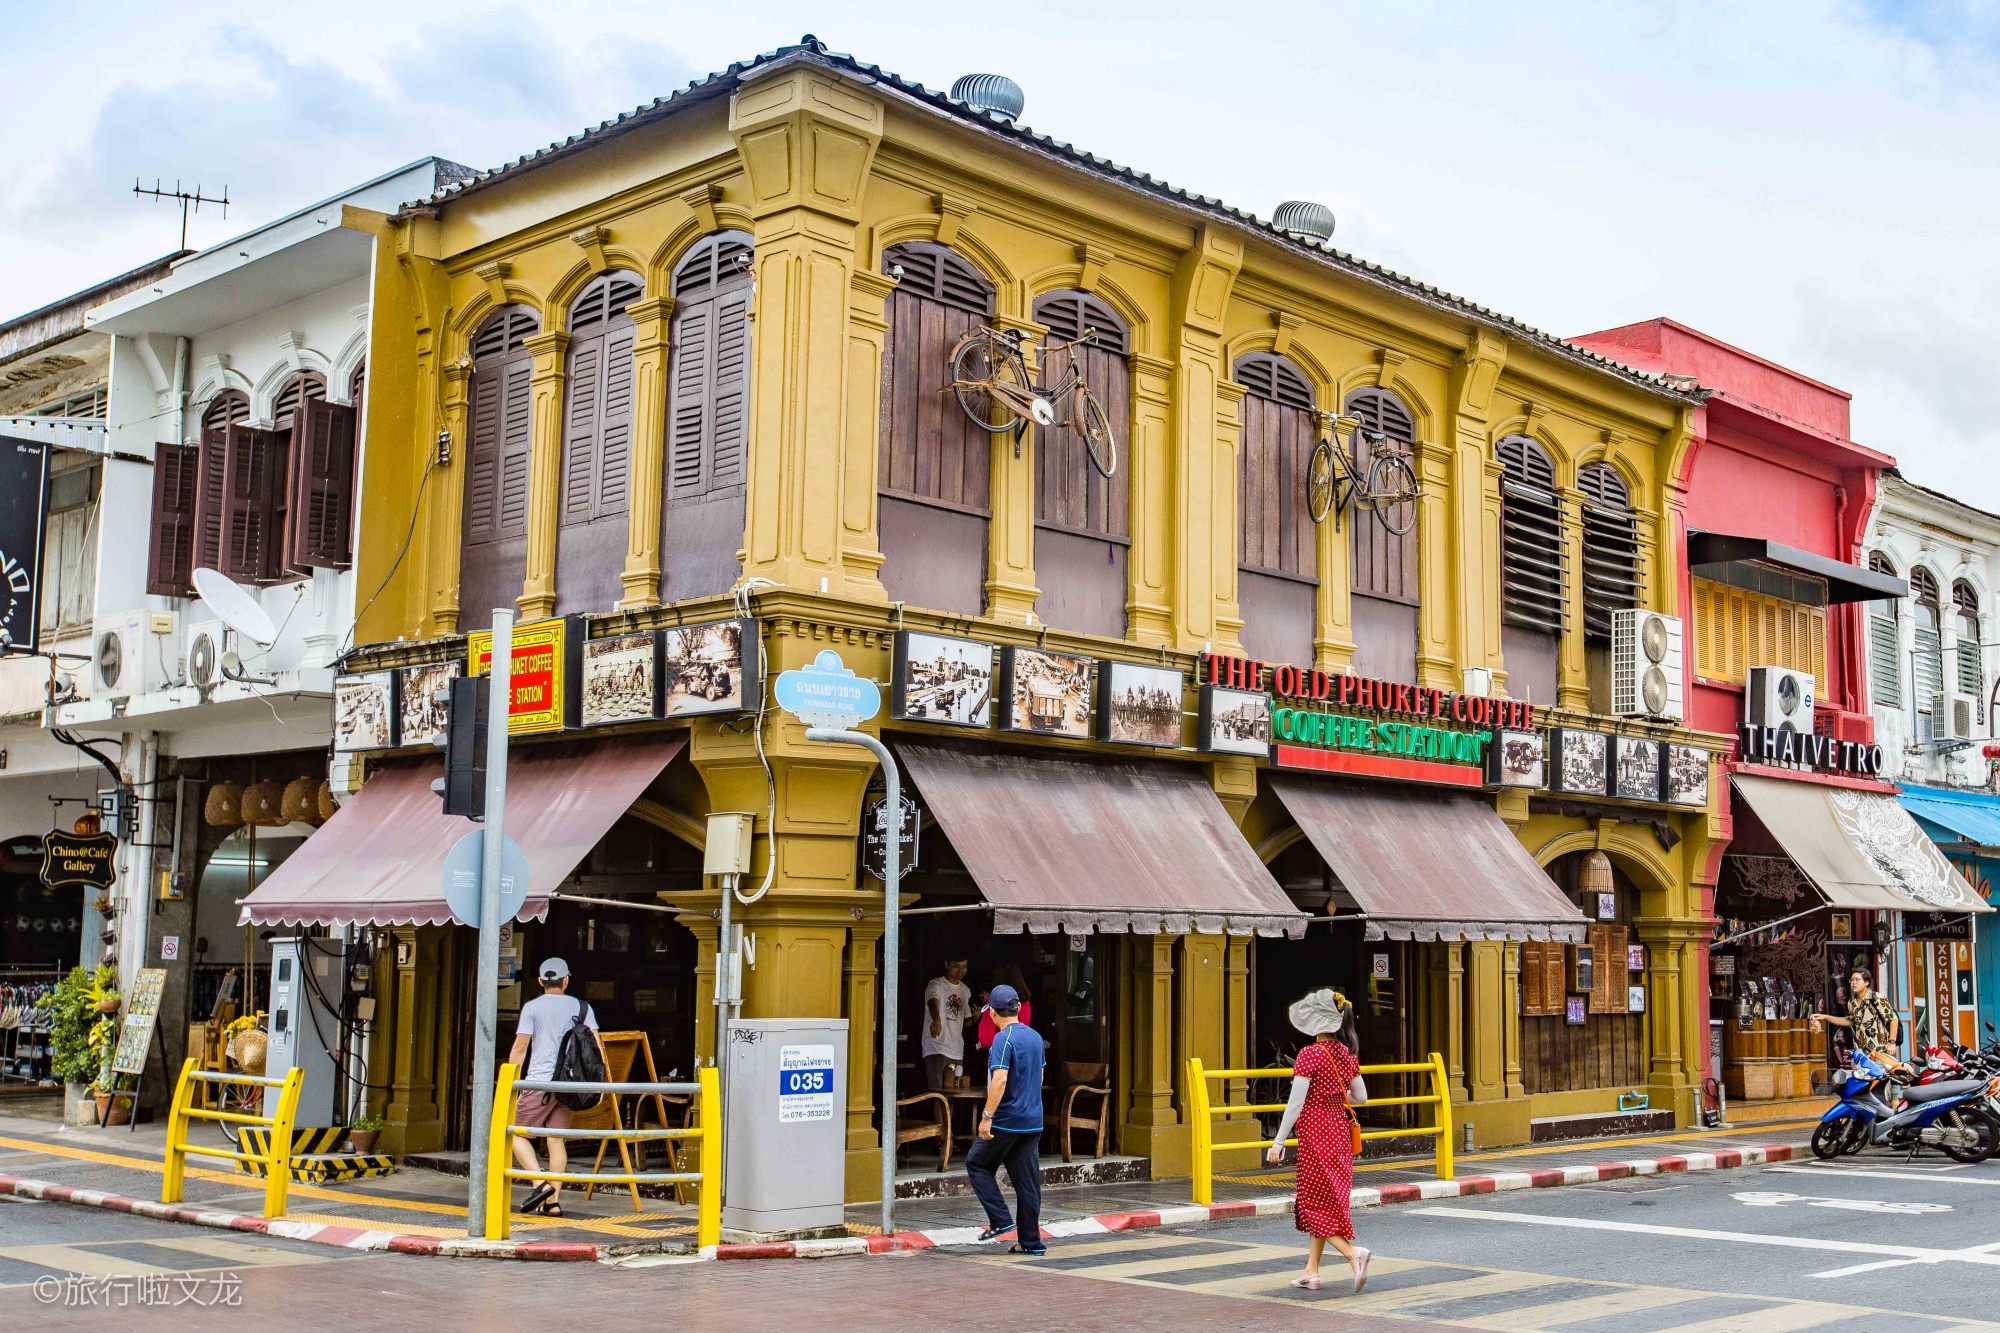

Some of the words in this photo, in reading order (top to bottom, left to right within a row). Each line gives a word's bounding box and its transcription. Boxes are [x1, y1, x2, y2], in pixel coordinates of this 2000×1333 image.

[529, 653, 553, 673] COFFEE
[1203, 653, 1265, 692] THE
[1273, 665, 1330, 699] OLD
[1337, 674, 1445, 718] PHUKET
[1452, 693, 1537, 732] COFFEE
[1744, 723, 1885, 774] THAIVETRO
[867, 834, 879, 844] The
[52, 846, 109, 858] Chino@Café
[63, 860, 96, 874] Gallery
[790, 1072, 824, 1091] 035
[791, 1110, 831, 1119] 076-353228
